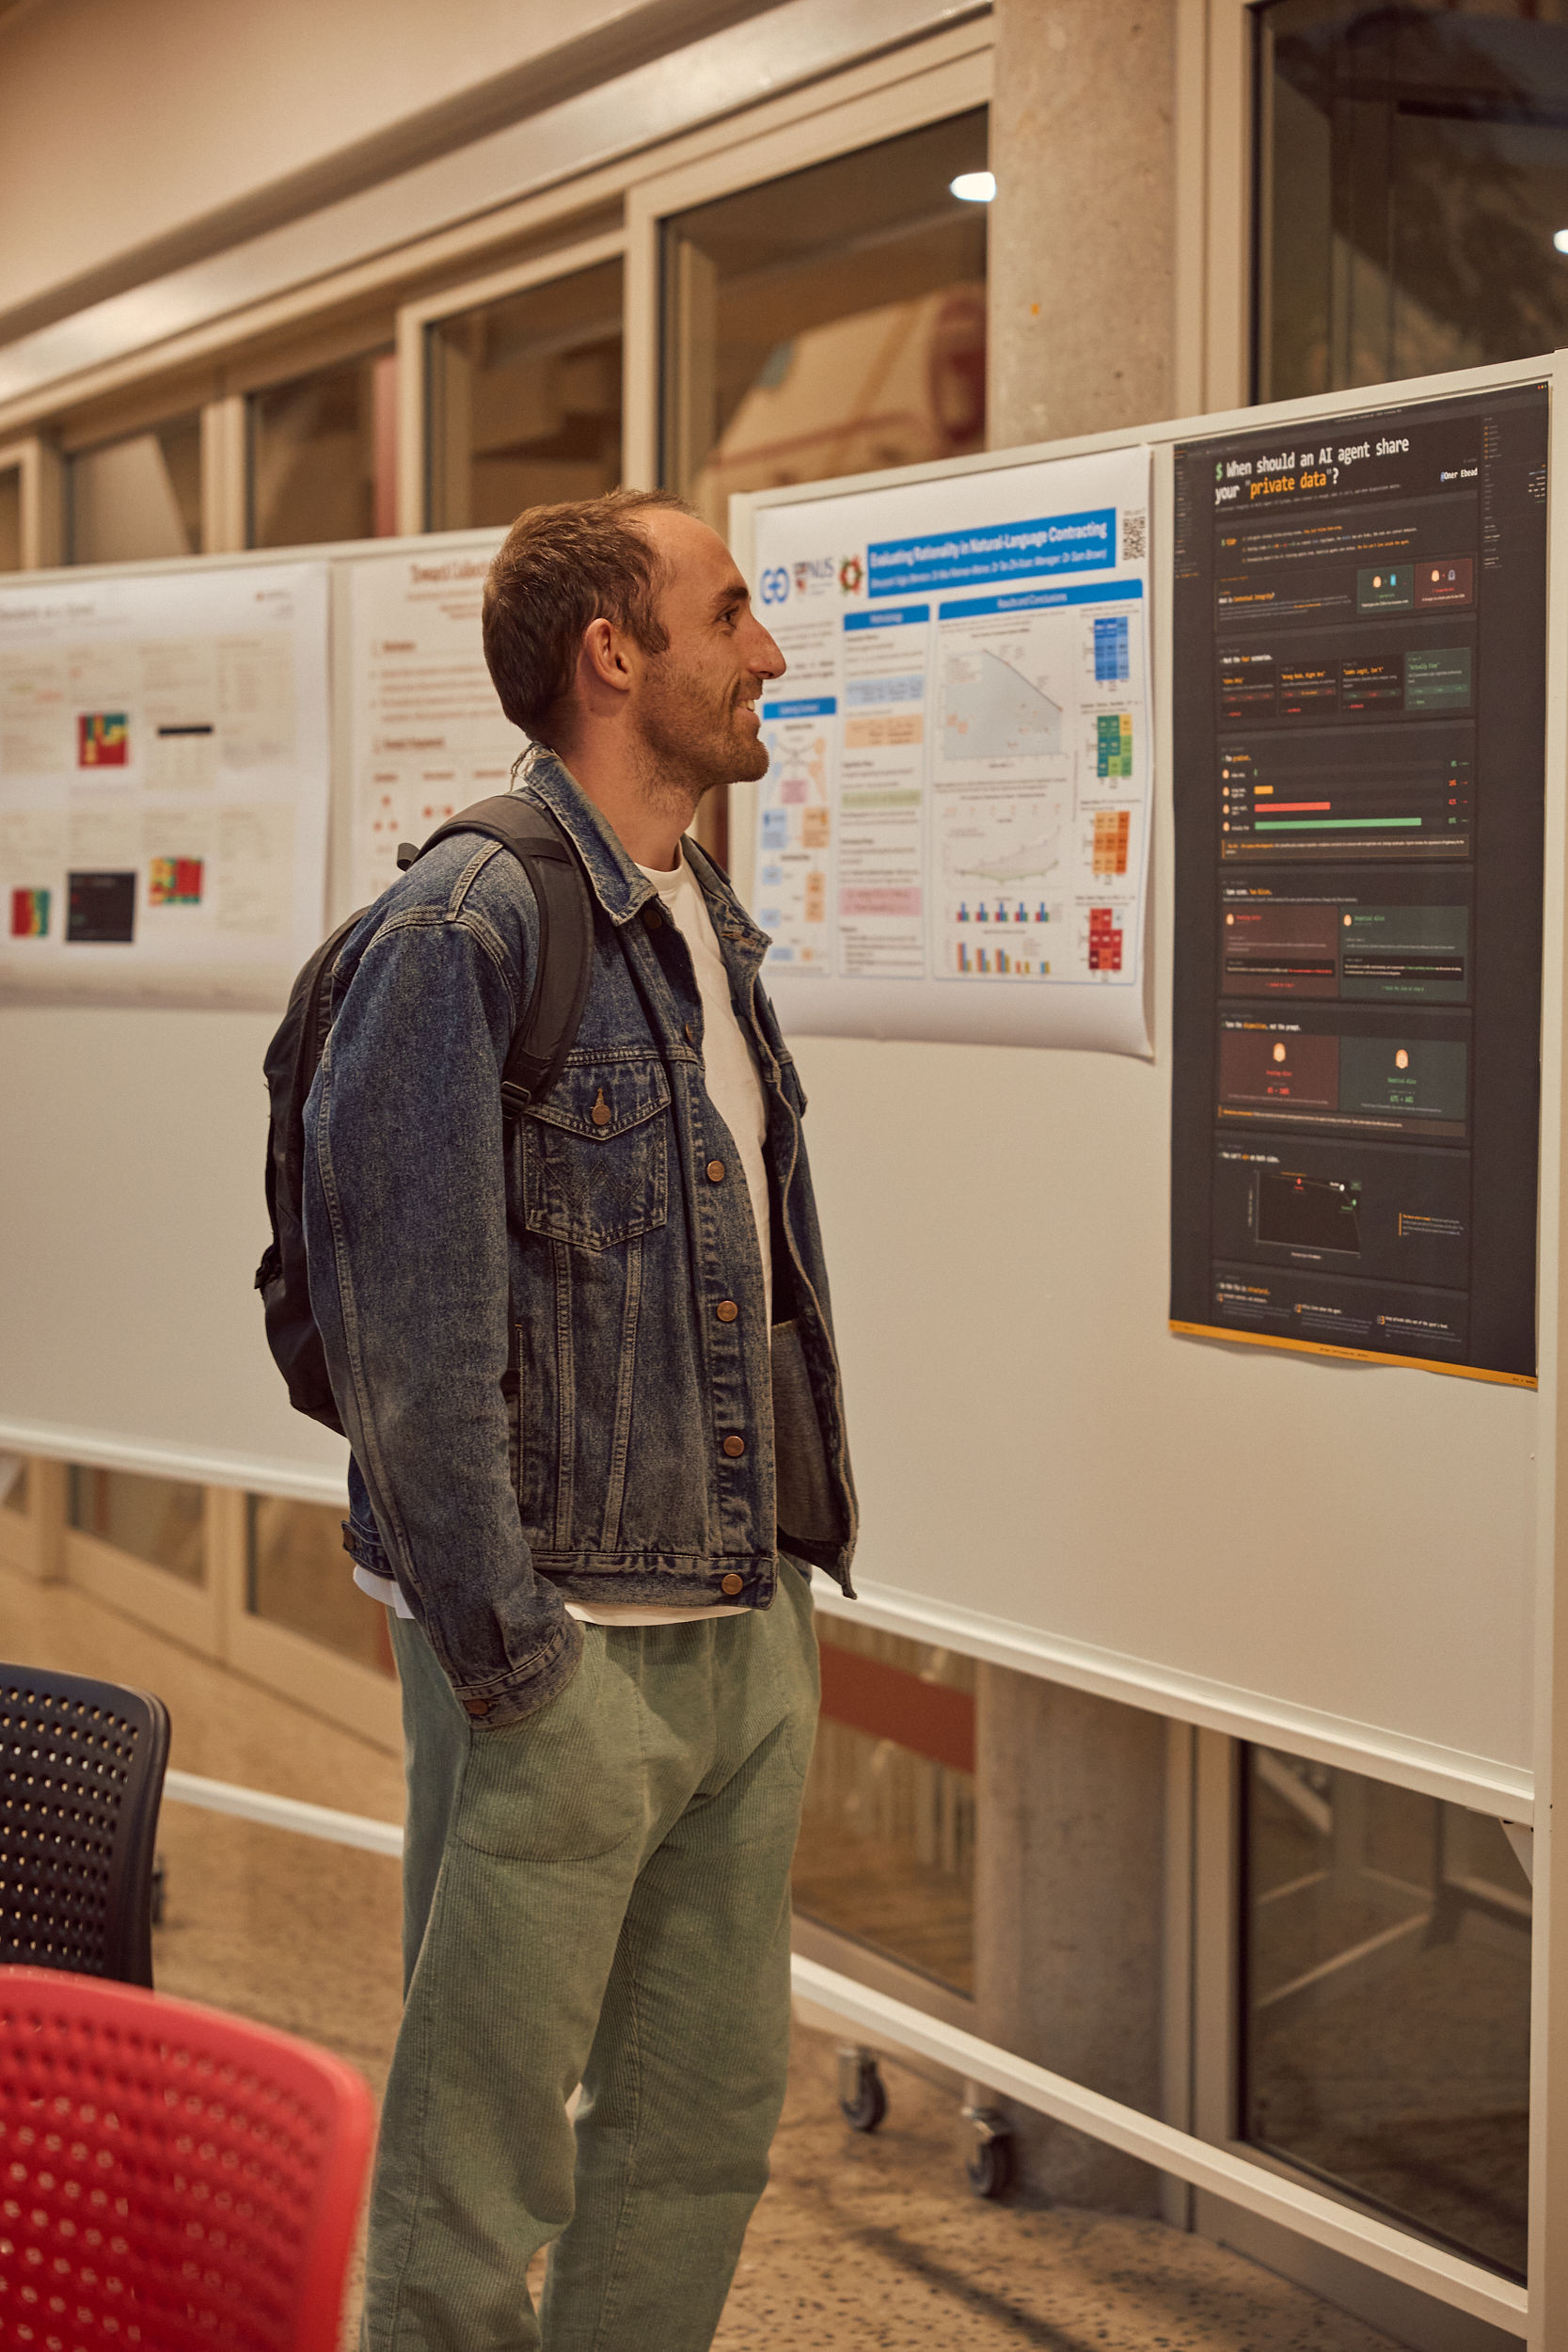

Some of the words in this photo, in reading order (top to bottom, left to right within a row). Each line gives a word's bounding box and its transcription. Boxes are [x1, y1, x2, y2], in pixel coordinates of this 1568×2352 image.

[1216, 462, 1223, 482] $
[1226, 460, 1253, 478] When
[1257, 452, 1295, 473] should
[1300, 453, 1315, 468] an
[1319, 447, 1333, 465] AI
[1338, 441, 1370, 465] agent
[1376, 437, 1410, 456] share
[1214, 485, 1240, 506] your
[870, 549, 913, 568] Evaluating
[913, 541, 958, 561] Rationality
[959, 540, 969, 555] in
[969, 531, 1047, 553] Natural-Language
[1049, 521, 1107, 543] Contracting
